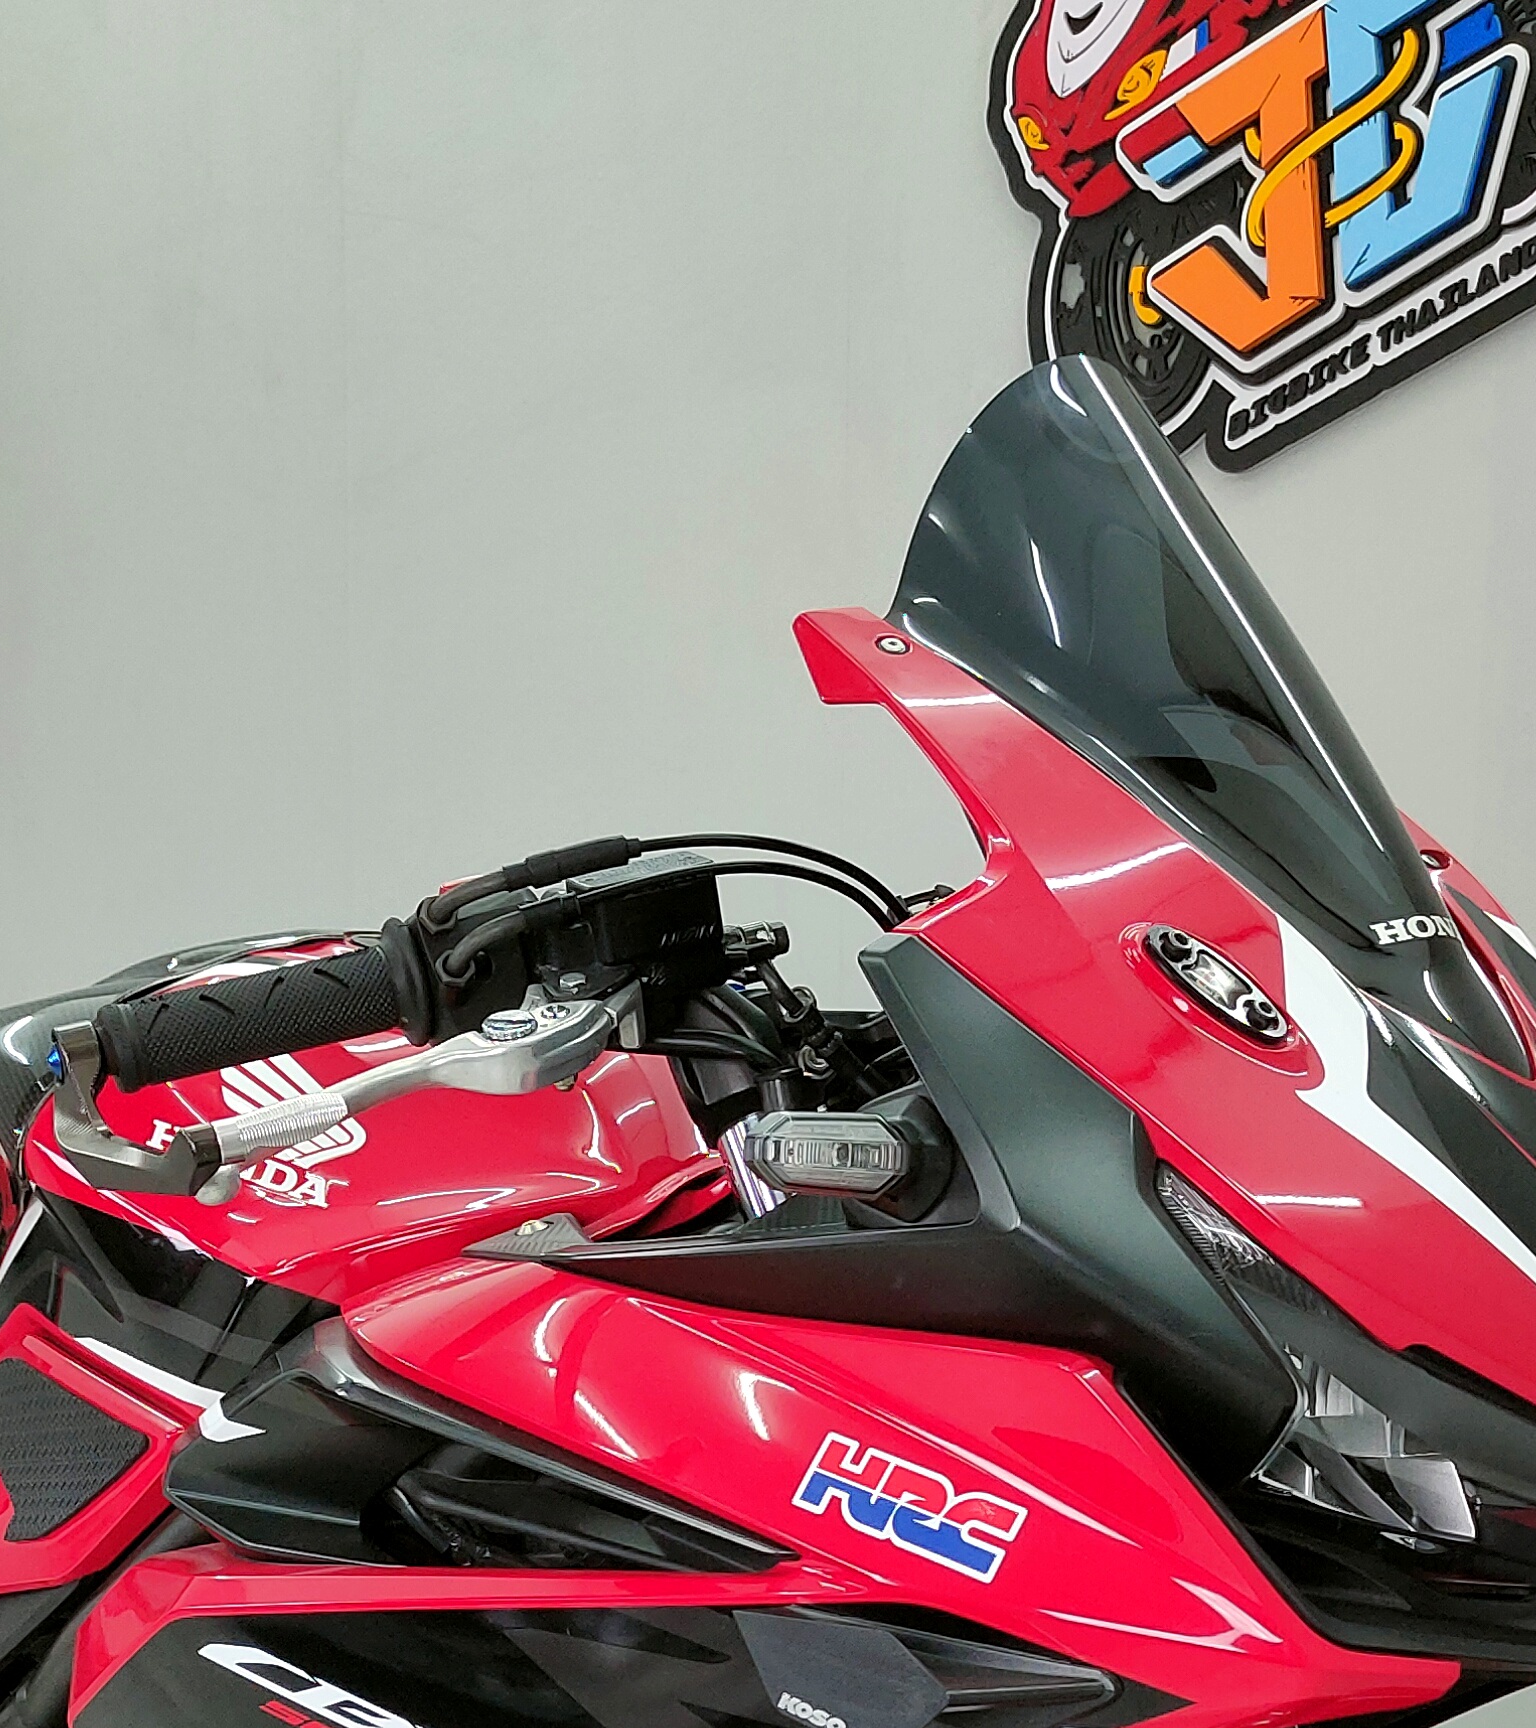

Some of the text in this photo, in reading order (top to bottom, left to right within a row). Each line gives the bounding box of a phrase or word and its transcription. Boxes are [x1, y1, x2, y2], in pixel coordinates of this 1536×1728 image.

[1228, 333, 1372, 441] BIGBIKE
[144, 1118, 329, 1209] HDA
[791, 1431, 1028, 1584] HRC
